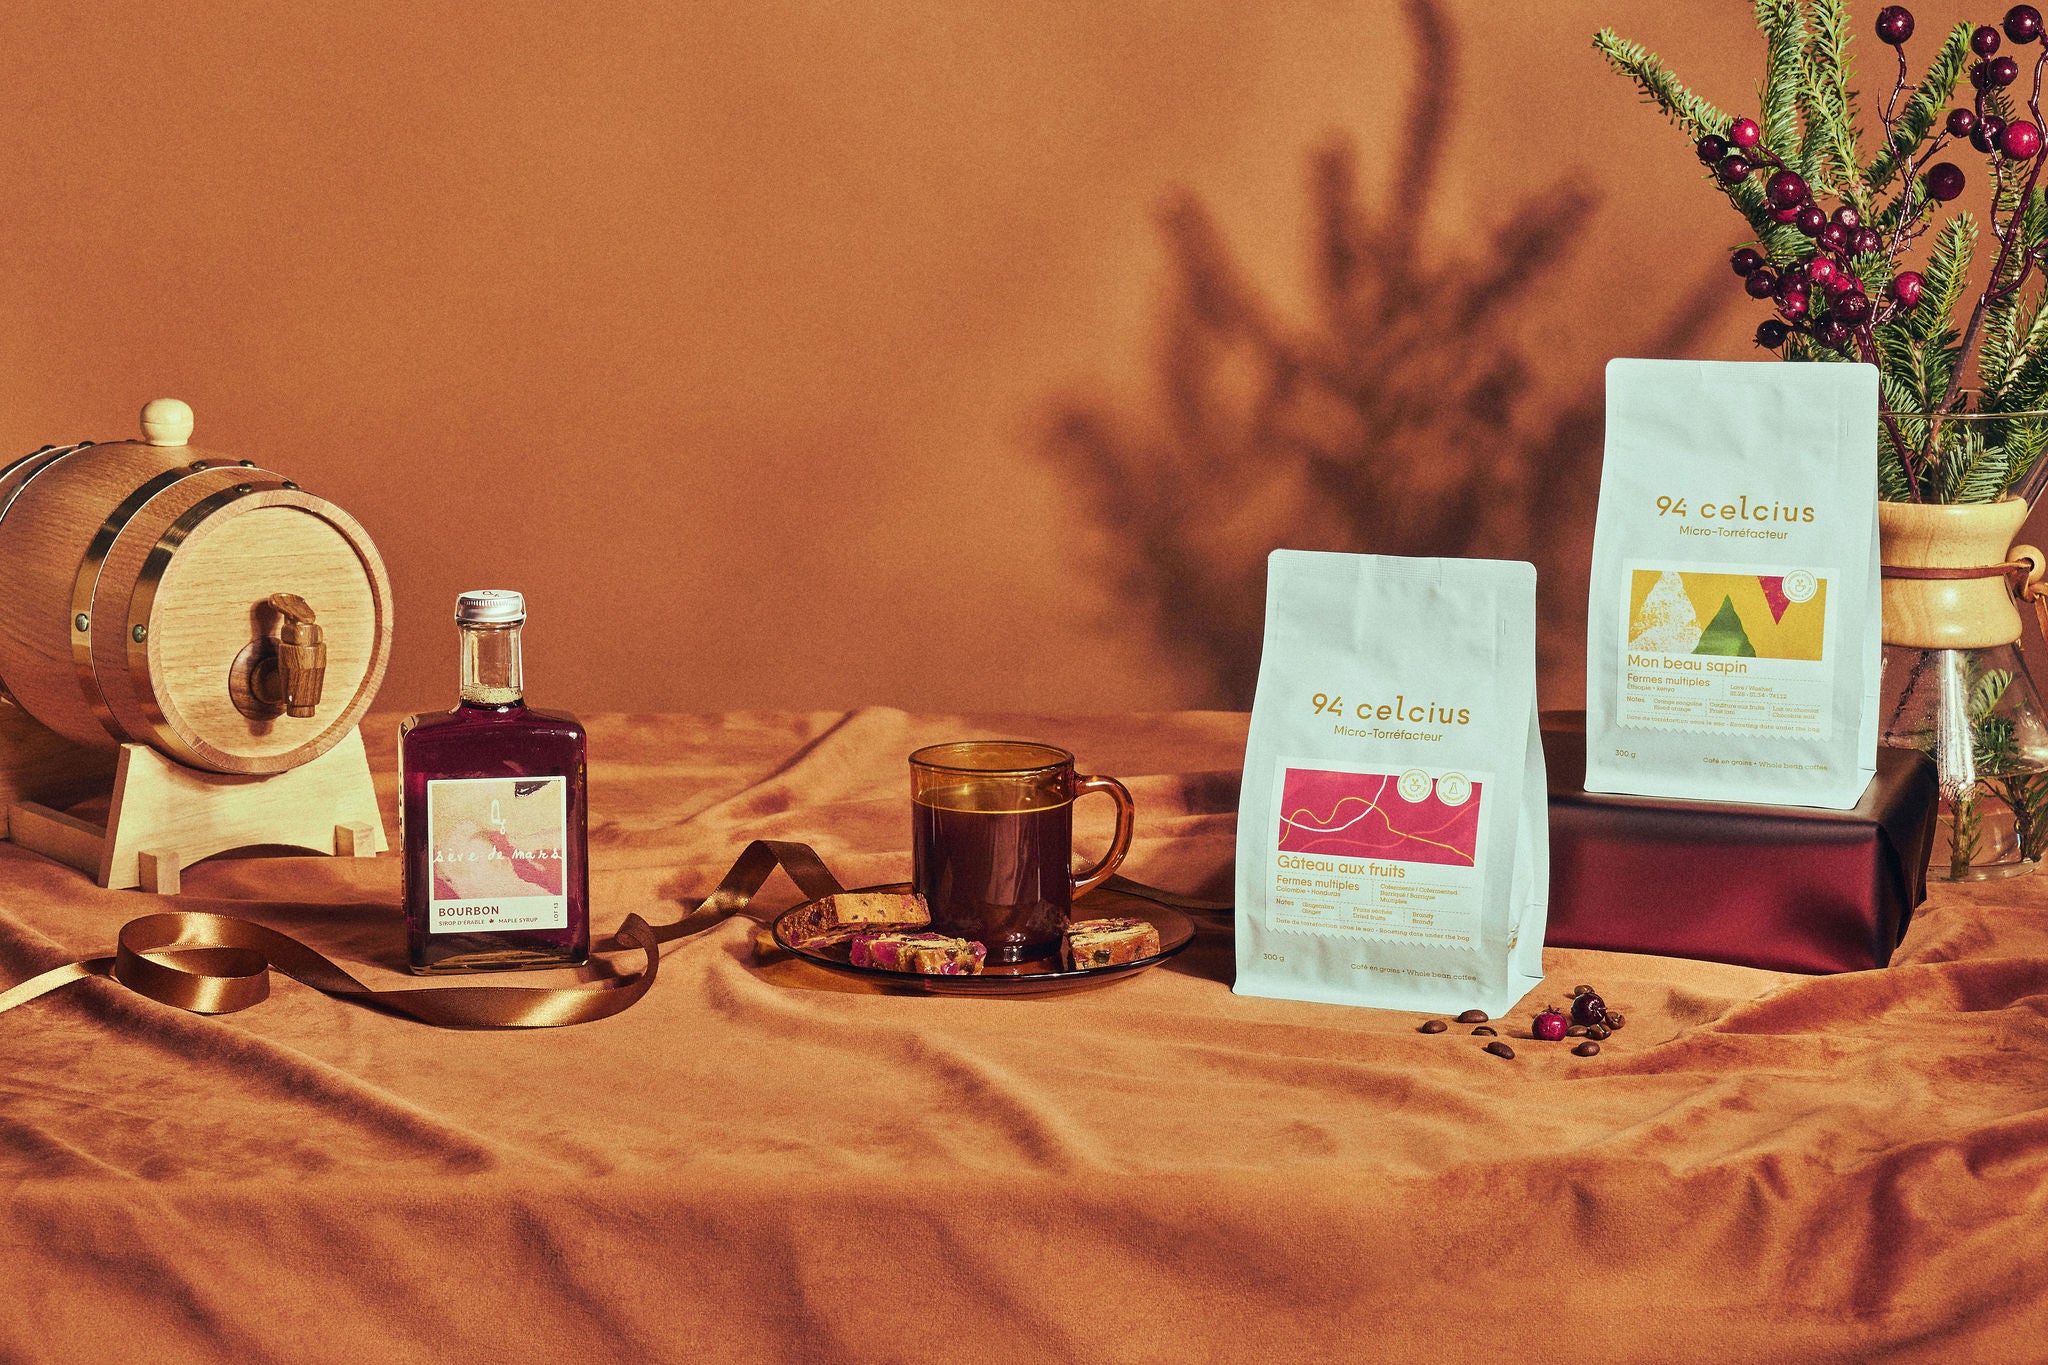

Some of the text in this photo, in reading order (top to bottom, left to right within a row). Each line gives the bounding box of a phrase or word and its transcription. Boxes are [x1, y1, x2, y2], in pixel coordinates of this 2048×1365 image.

[1656, 495, 1815, 523] 94 celcius
[1679, 525, 1788, 540] Micro-Torréfacteur
[1627, 654, 1747, 676] Mon beau sapin
[1627, 673, 1710, 687] Fermes multiples
[1626, 695, 1645, 703] Notes
[1311, 692, 1471, 725] 94 celcius
[1333, 724, 1443, 742] Micro-Torréfacteur
[1615, 749, 1629, 757] 300
[1731, 759, 1752, 767] grains
[488, 845, 505, 860] de
[512, 847, 563, 861] mars
[1277, 854, 1406, 879] Gâteau aux fruits
[1276, 874, 1360, 891] Fermes multiples
[1275, 898, 1294, 906] Notes
[438, 906, 499, 917] BOURBON
[1412, 911, 1434, 919] Brandy
[1412, 918, 1434, 926] Brandy
[1263, 952, 1278, 961] 300
[1379, 966, 1400, 974] grains
[1406, 968, 1430, 977] Whole
[1431, 971, 1452, 980] bean
